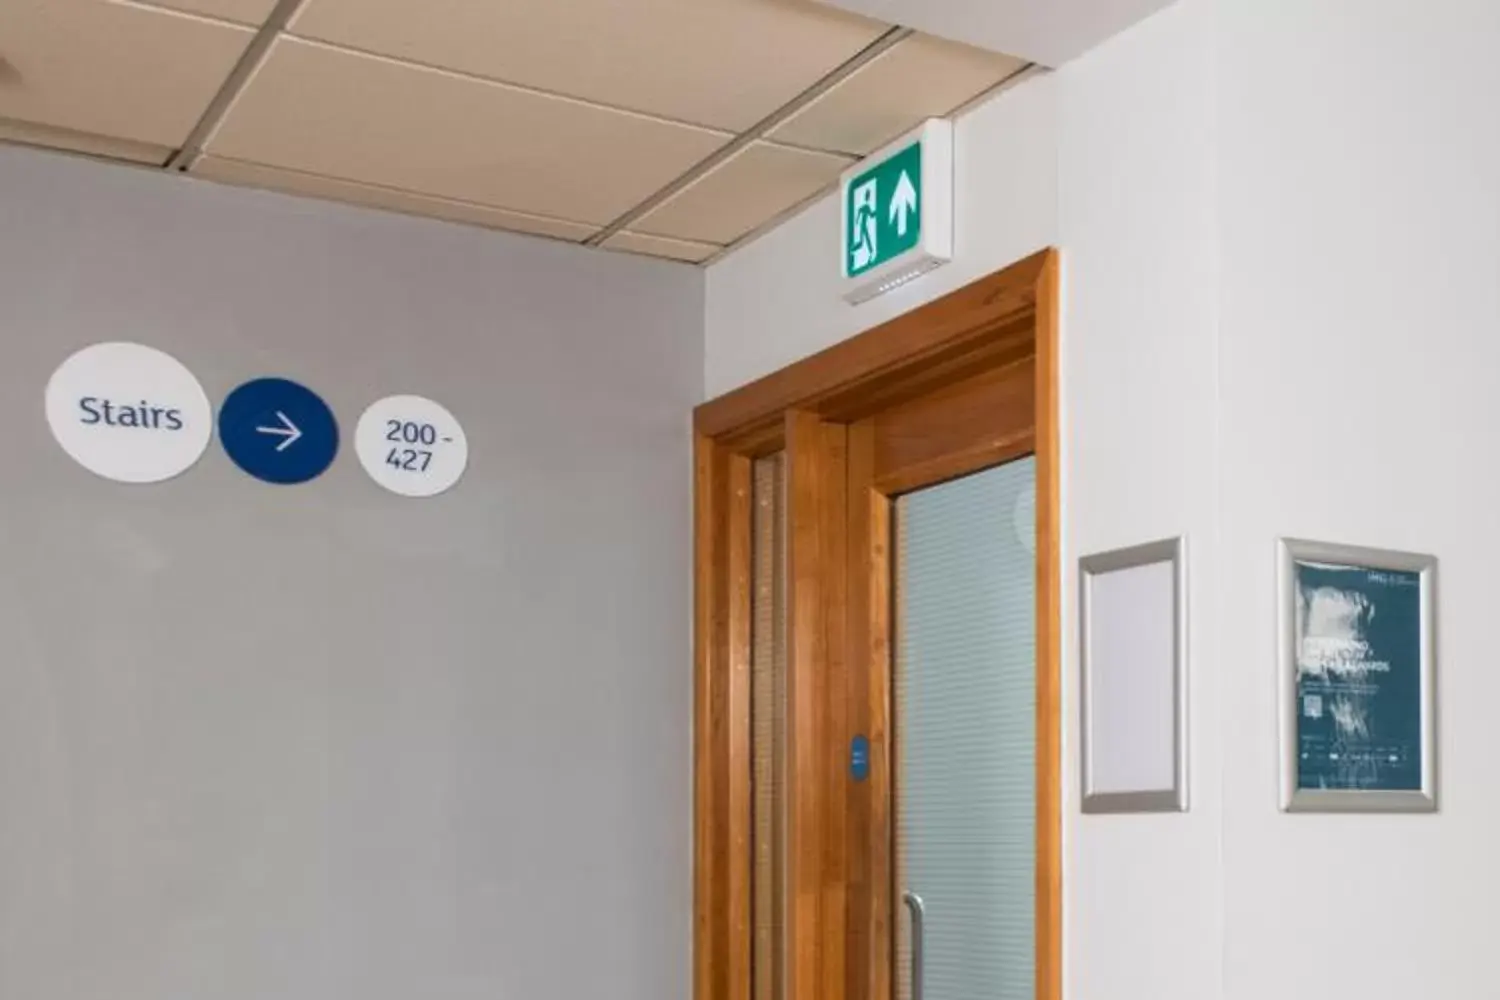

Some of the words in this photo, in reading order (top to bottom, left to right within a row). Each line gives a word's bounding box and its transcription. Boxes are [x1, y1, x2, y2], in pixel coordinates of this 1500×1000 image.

[80, 396, 183, 431] Stairs
[386, 419, 436, 446] 200
[385, 448, 432, 472] 427
